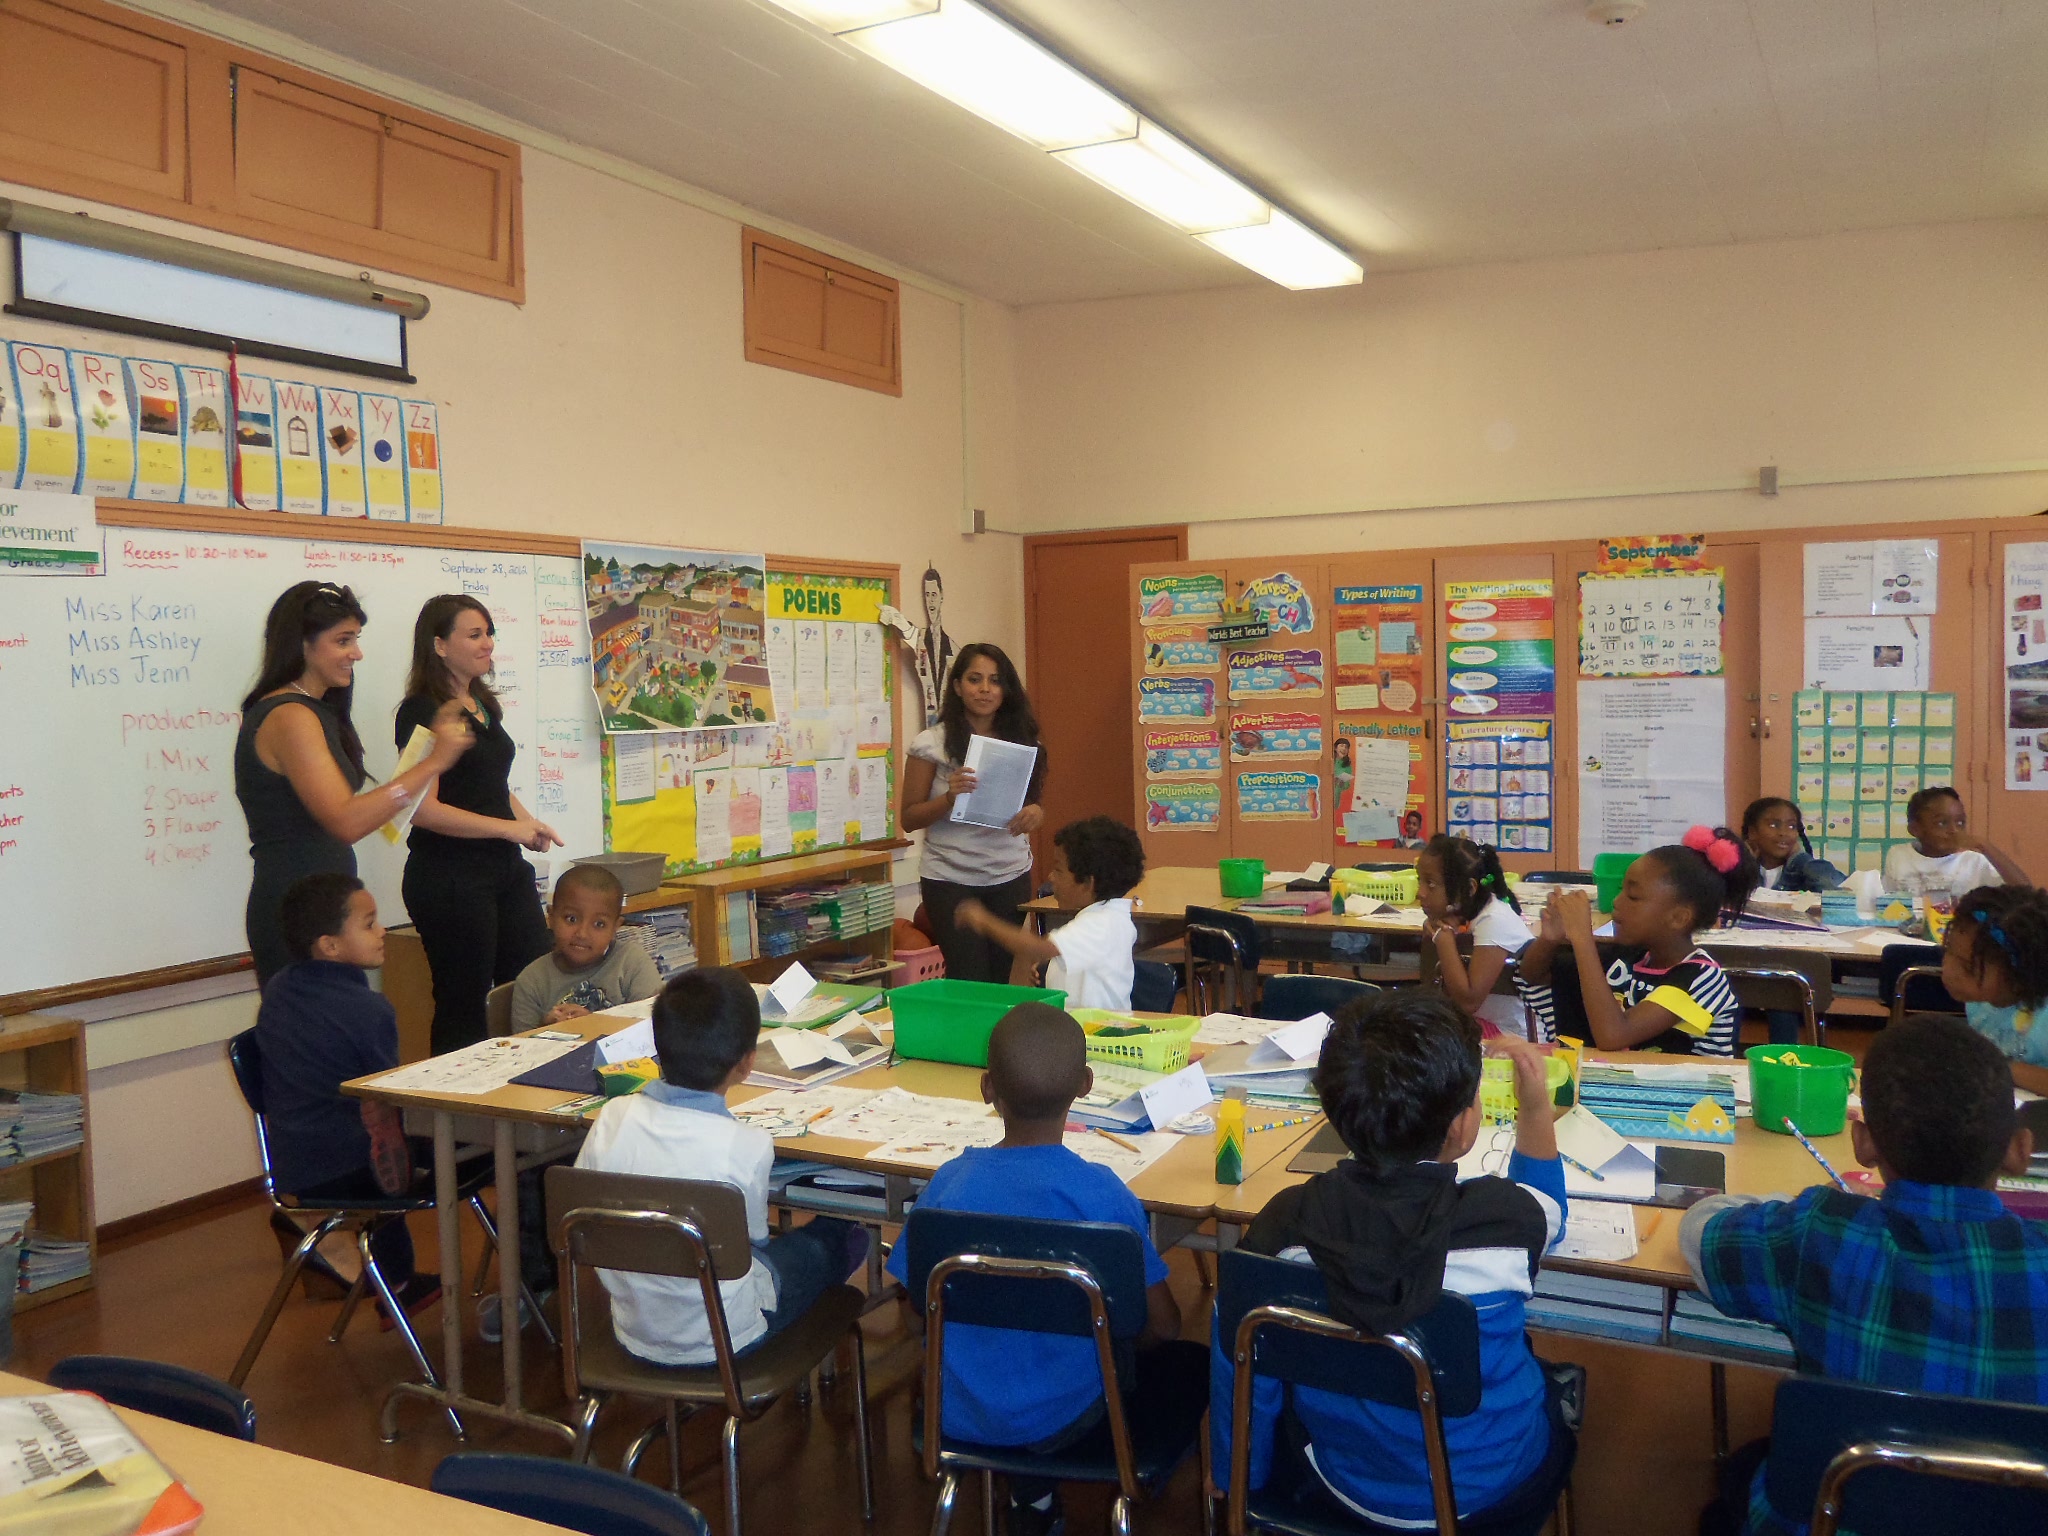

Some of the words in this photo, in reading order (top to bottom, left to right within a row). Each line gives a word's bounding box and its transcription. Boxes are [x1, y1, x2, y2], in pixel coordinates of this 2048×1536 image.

[1608, 544, 1699, 562] September
[441, 557, 488, 579] September
[462, 580, 489, 592] Friday
[1145, 579, 1178, 592] Nouns
[1253, 579, 1289, 597] Parts
[1450, 585, 1468, 594] The
[1470, 583, 1507, 594] Writing
[1341, 589, 1368, 600] Types
[1369, 591, 1379, 600] of
[1380, 587, 1417, 600] Writing
[66, 597, 122, 622] Miss
[131, 594, 196, 621] Karen
[783, 588, 842, 616] POEMS
[1624, 603, 1632, 614] 4
[1643, 601, 1653, 613] 5
[1664, 600, 1673, 611] 6
[1588, 604, 1597, 615] 2
[1606, 603, 1615, 615] 3
[1604, 622, 1615, 632] 10
[1644, 620, 1657, 631] 12
[1663, 620, 1675, 630] 13
[1683, 619, 1693, 629] 14
[1703, 619, 1716, 629] 15
[1146, 627, 1193, 641] Pronouns
[69, 629, 120, 655] Miss
[129, 626, 201, 662] Ashley
[1662, 640, 1675, 649] 20
[1702, 640, 1717, 648] 22
[1231, 652, 1285, 668] Adjectives
[71, 664, 120, 688] Miss
[130, 655, 190, 684] Jenn
[1142, 678, 1171, 692] Verbs
[1233, 715, 1275, 730] Adverbs
[1339, 721, 1385, 739] Friendly
[1387, 723, 1423, 736] Letter
[1460, 726, 1503, 735] Literature
[1505, 724, 1535, 734] Genres
[1148, 733, 1211, 747] Interjections
[1241, 773, 1306, 787] Prepositions
[1149, 784, 1214, 797] Conjunctions
